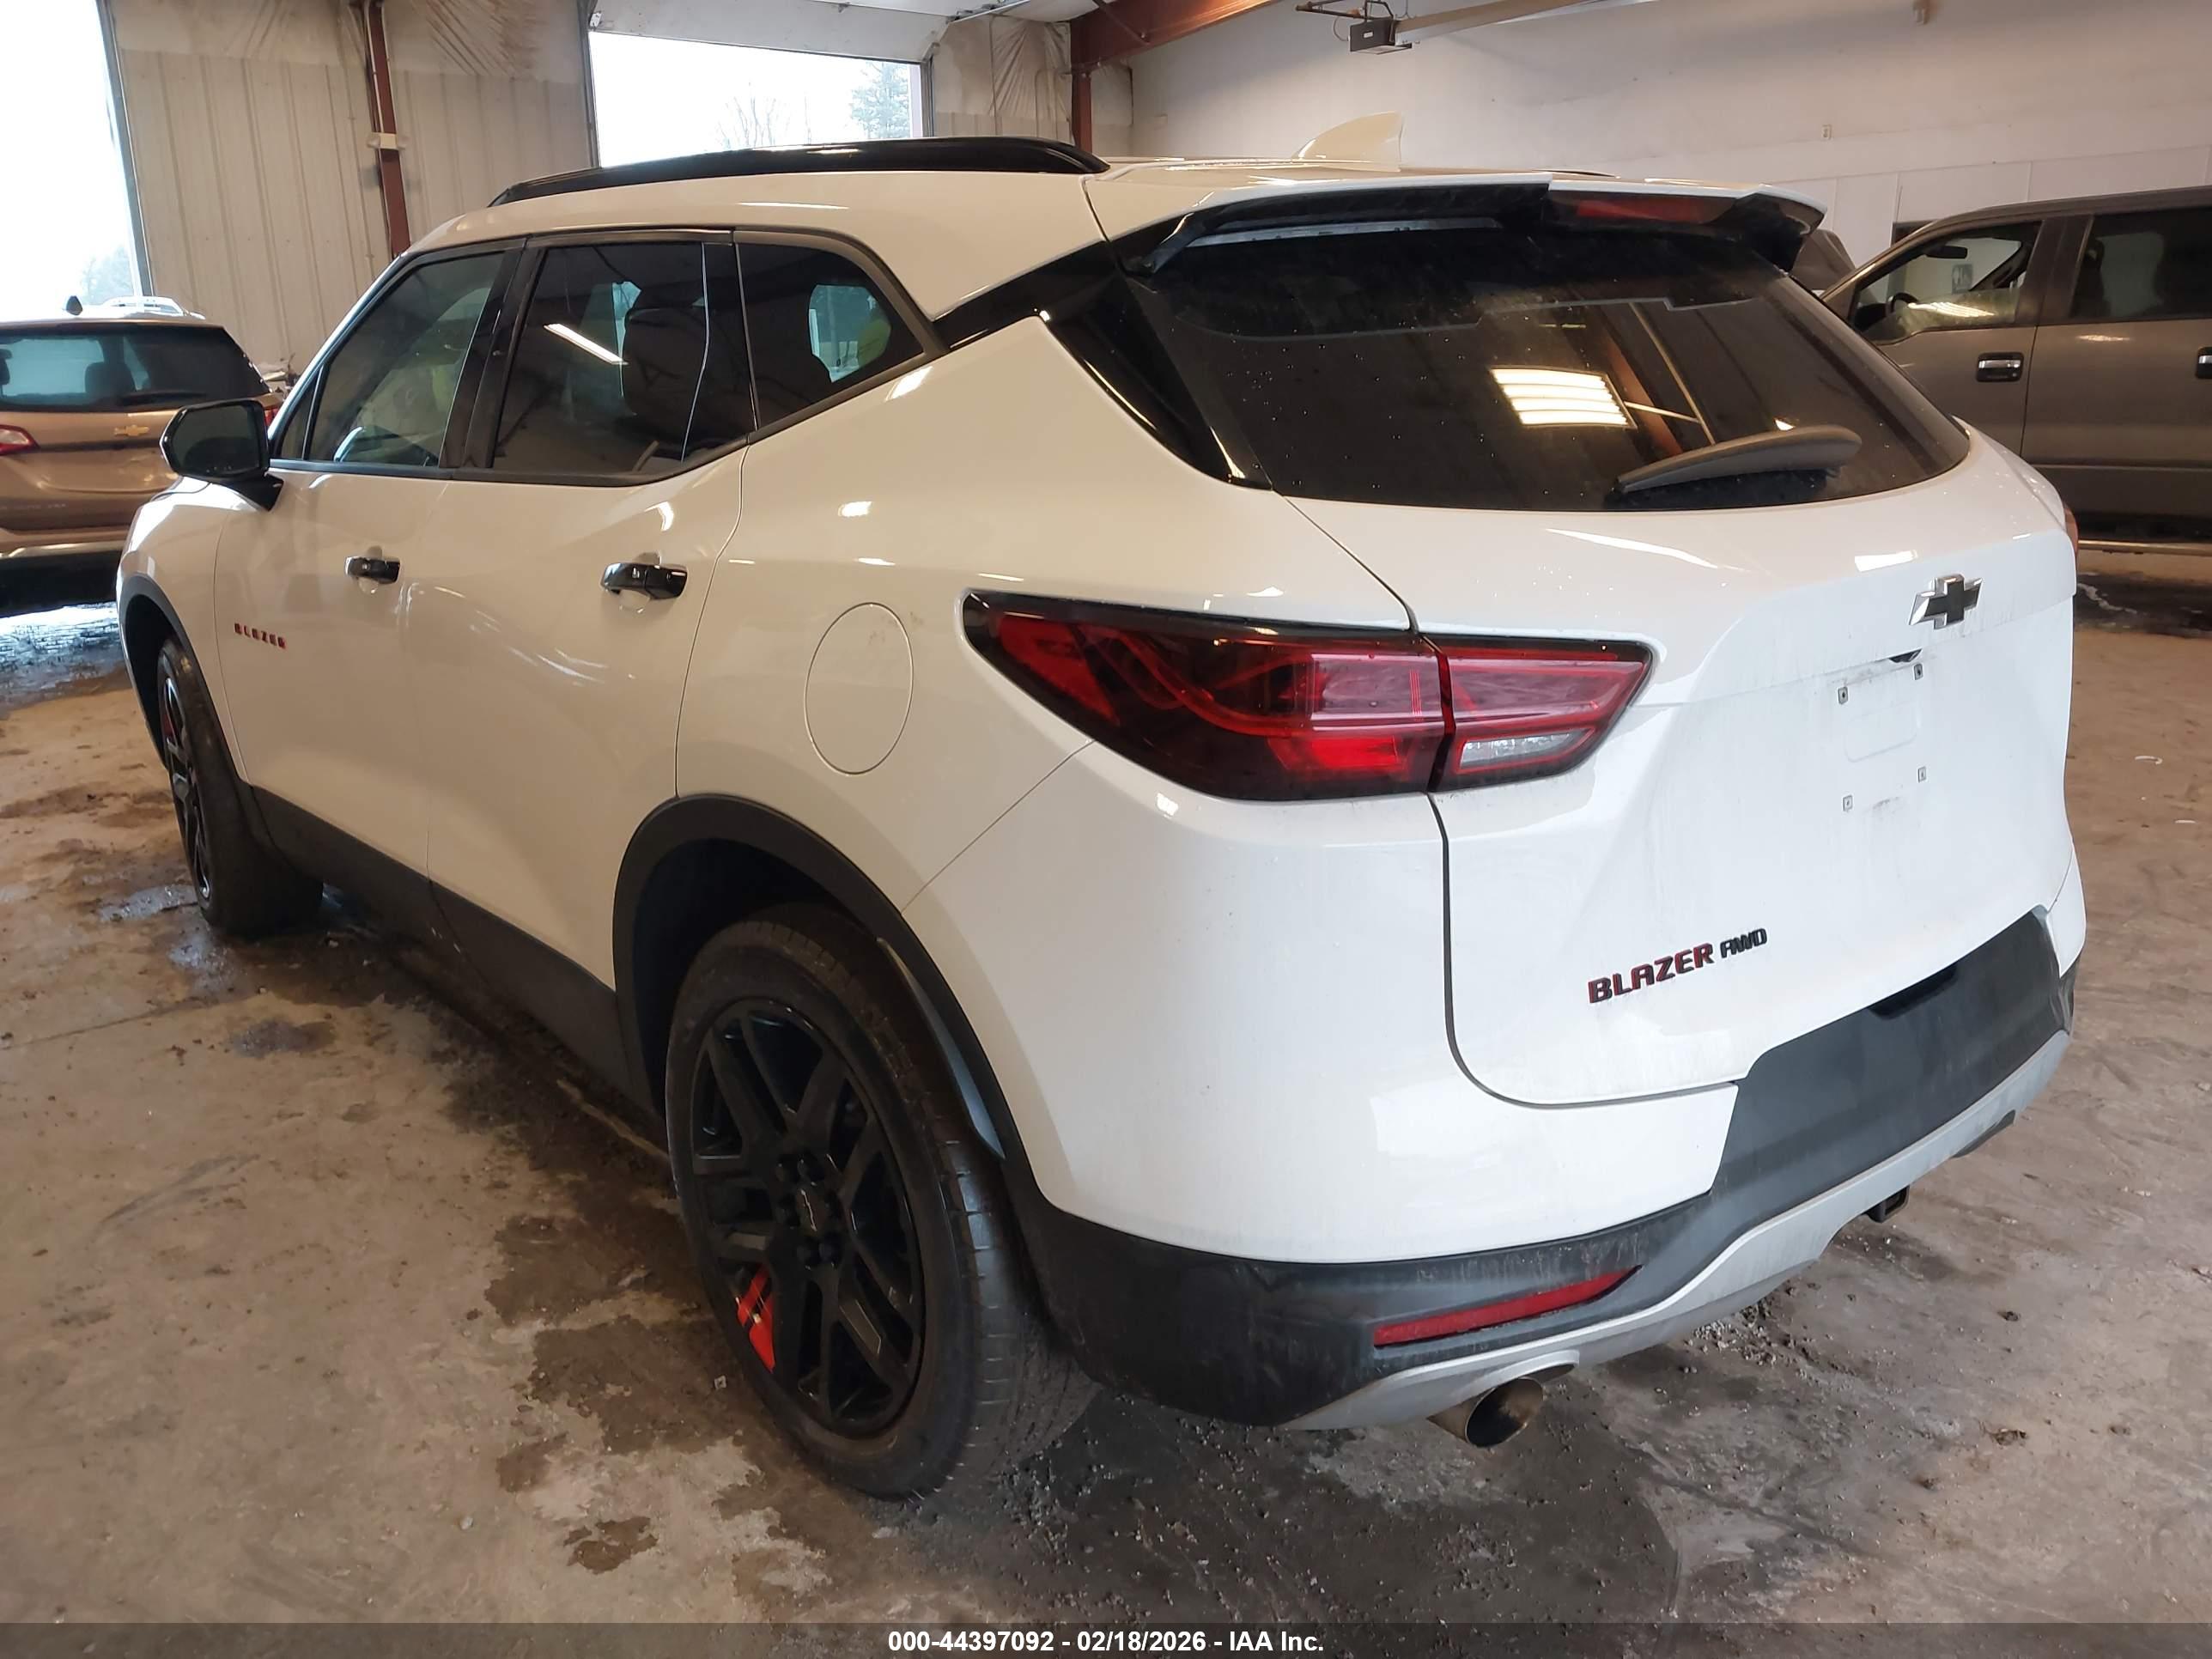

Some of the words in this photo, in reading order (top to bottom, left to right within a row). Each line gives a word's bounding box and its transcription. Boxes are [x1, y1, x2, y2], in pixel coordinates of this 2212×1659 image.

[234, 623, 287, 650] BLAZER
[1588, 943, 1715, 1004] BLAZER
[1720, 927, 1768, 958] AWD
